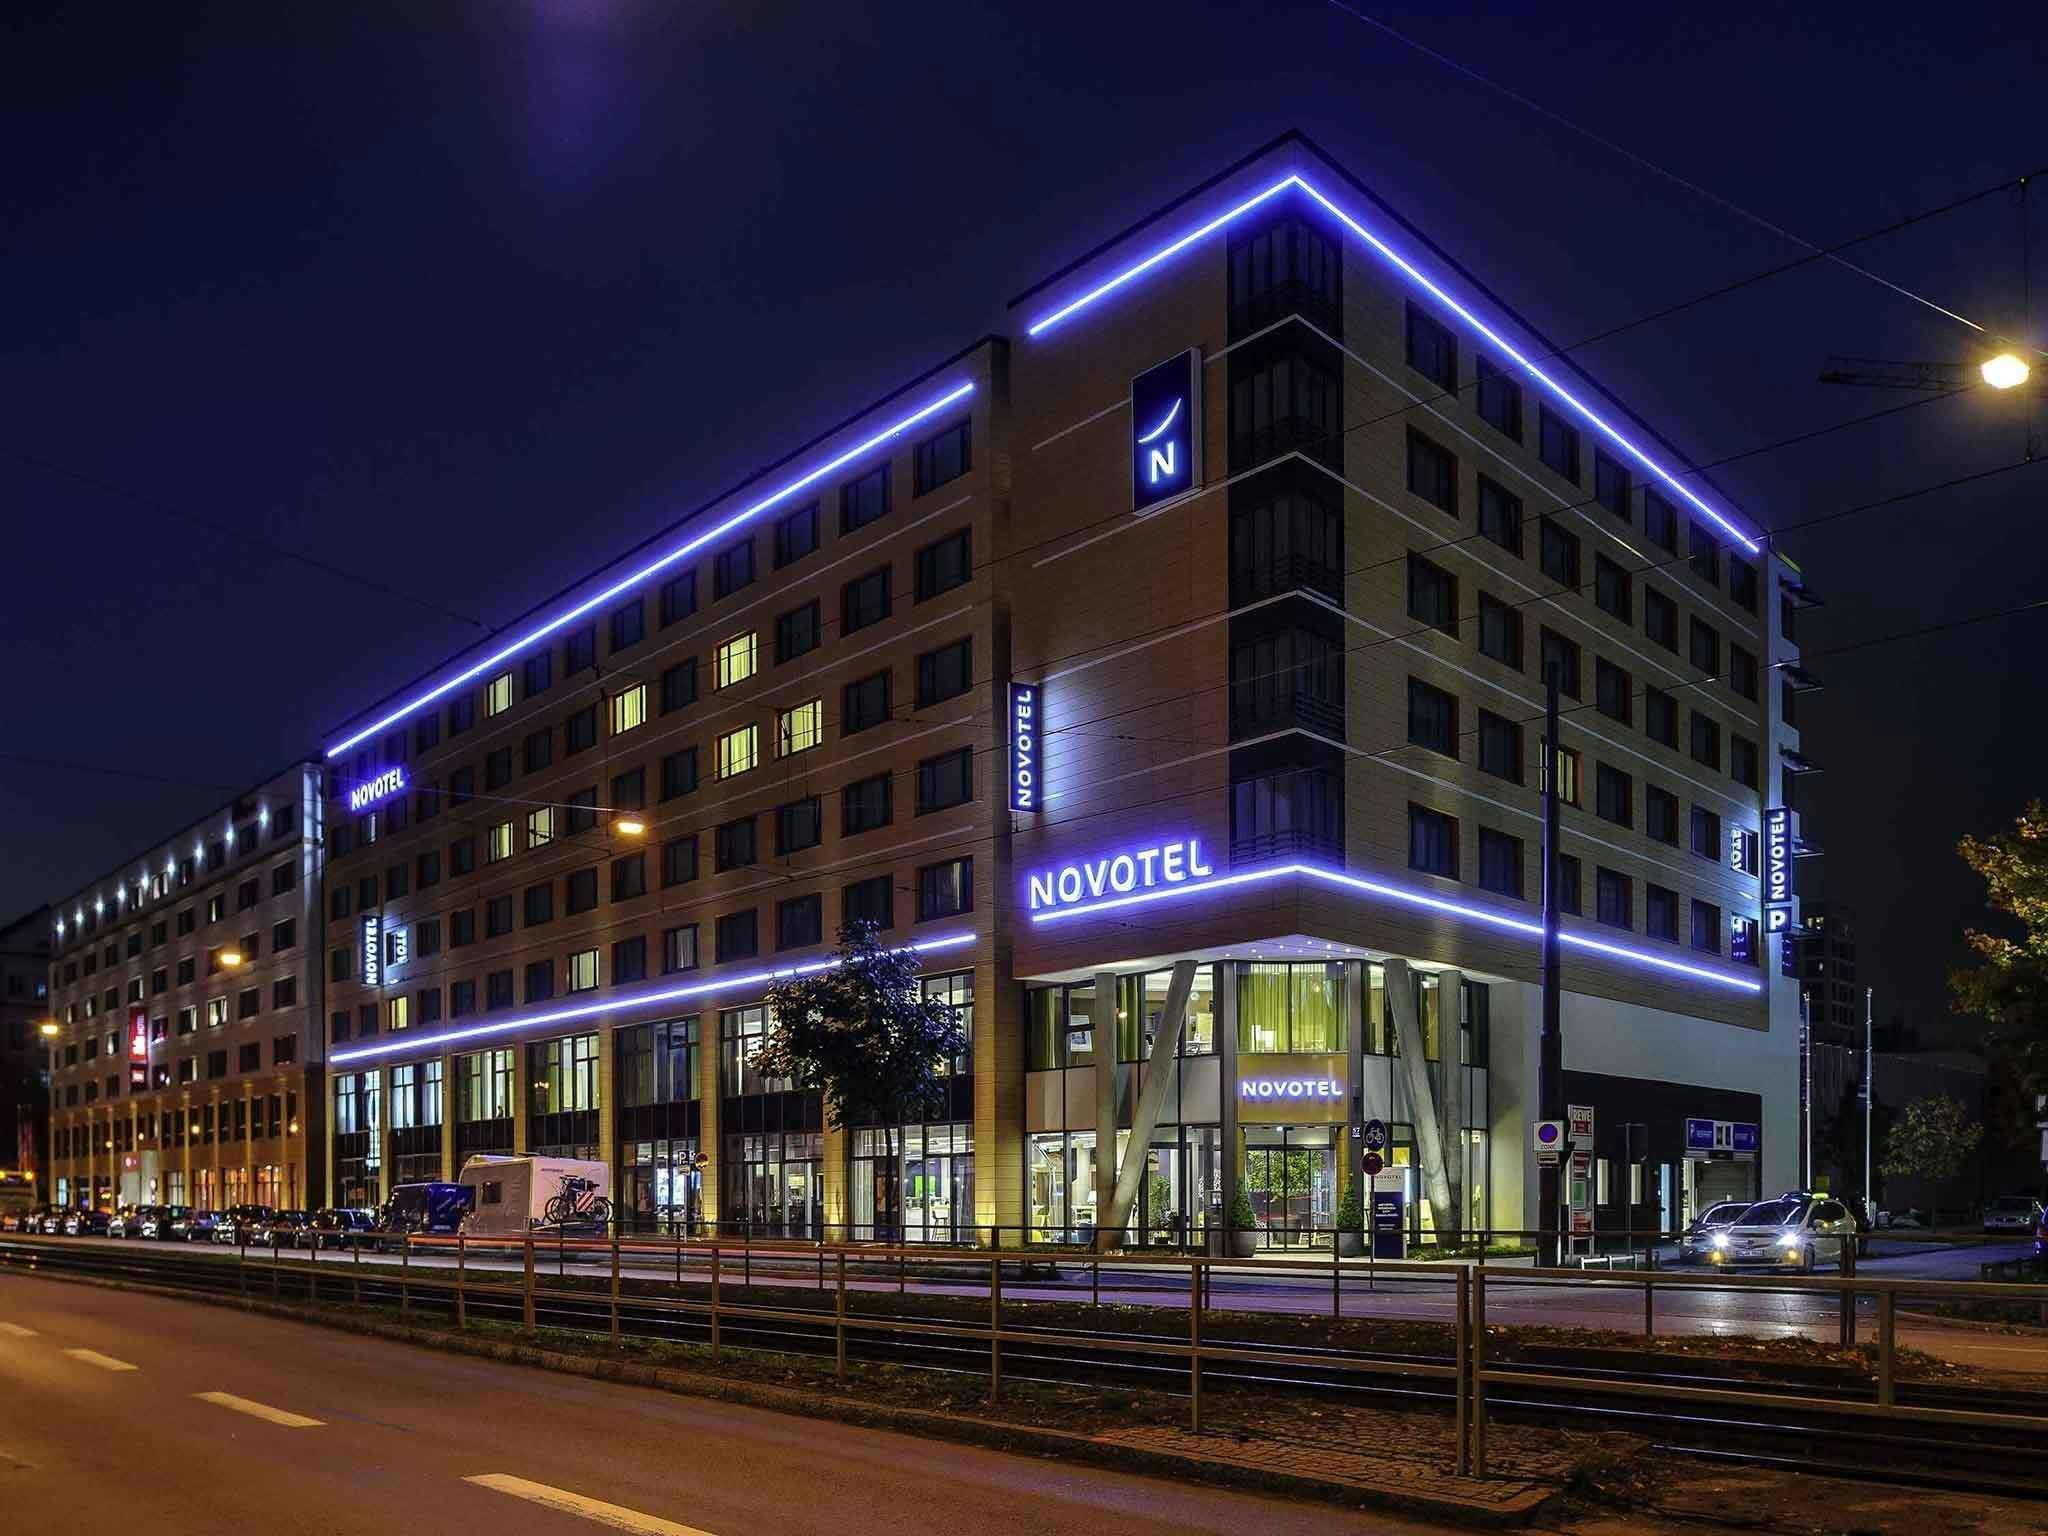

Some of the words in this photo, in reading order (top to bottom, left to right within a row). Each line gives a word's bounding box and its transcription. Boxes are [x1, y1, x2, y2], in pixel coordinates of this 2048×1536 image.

[1151, 441, 1175, 484] N
[1018, 690, 1032, 807] NOVOTEL
[351, 768, 404, 811] NOVOTEL
[1030, 840, 1212, 909] NOVOTEL
[1771, 811, 1785, 899] NOVOTEL
[1770, 911, 1786, 930] P
[365, 918, 377, 984] NOVOTEL
[1242, 1081, 1343, 1097] NOVOTEL
[679, 1151, 687, 1165] P
